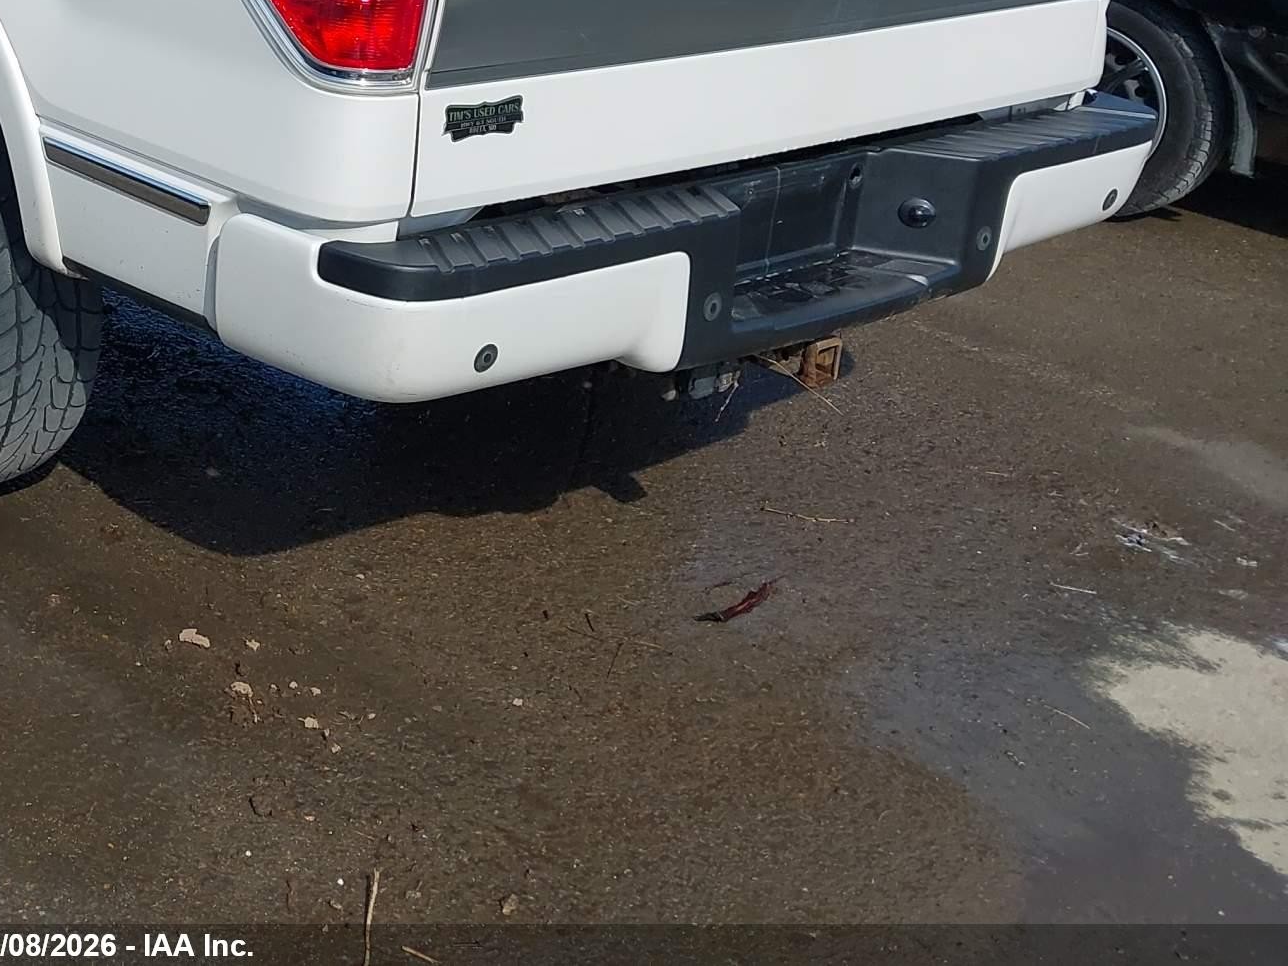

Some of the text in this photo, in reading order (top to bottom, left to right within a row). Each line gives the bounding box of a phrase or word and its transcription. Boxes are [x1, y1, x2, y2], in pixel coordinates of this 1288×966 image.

[448, 102, 519, 122] TIM'S USED CARS
